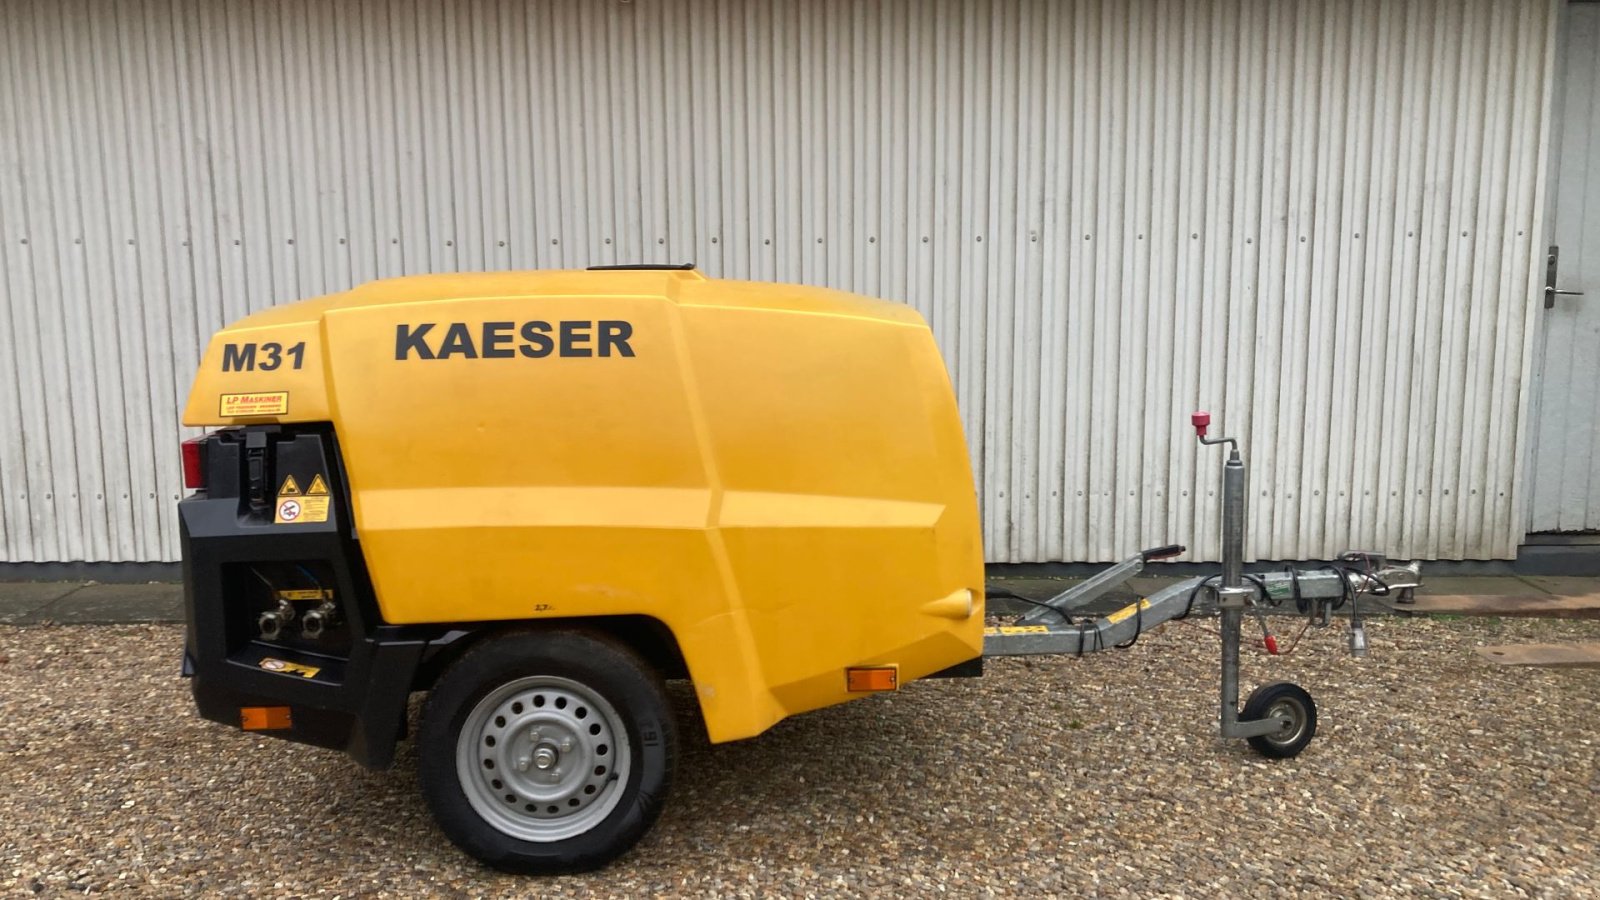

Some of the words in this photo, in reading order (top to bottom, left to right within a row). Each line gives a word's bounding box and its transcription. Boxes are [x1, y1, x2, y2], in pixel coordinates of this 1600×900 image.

[395, 320, 636, 360] KAESER
[222, 342, 305, 372] M31
[226, 396, 239, 404] LP
